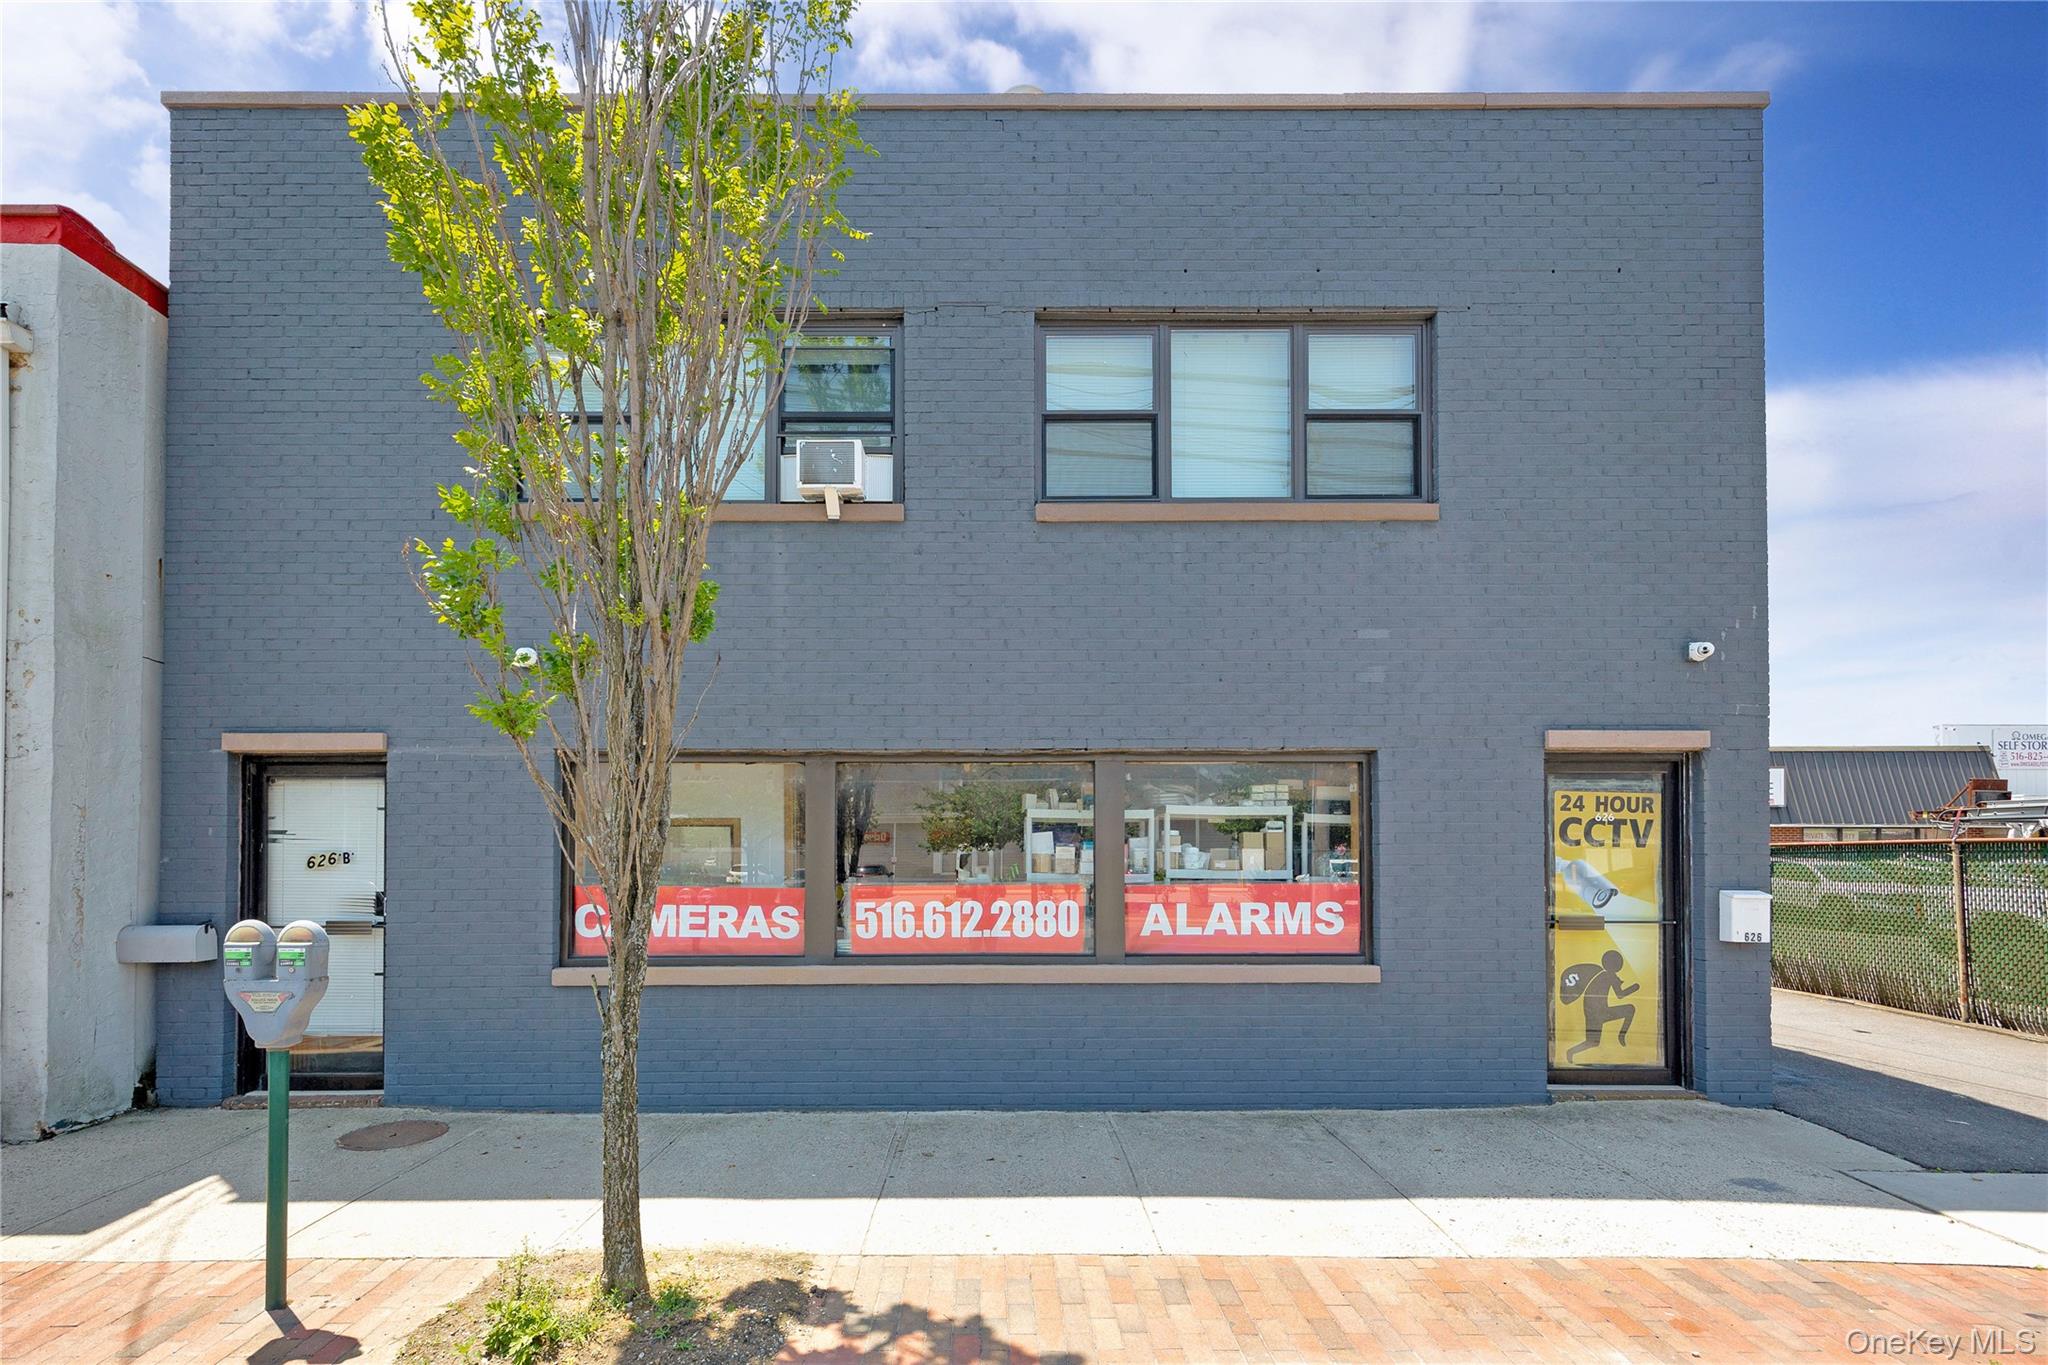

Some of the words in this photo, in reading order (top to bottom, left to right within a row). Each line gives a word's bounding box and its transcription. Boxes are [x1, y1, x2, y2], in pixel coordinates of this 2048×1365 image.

[2022, 733, 2048, 741] OMEG
[1997, 741, 2019, 750] SELF
[2010, 752, 2048, 761] 516-825-
[1560, 794, 1585, 812] 24
[1595, 795, 1655, 814] HOUR
[1594, 812, 1615, 822] 626
[1558, 816, 1655, 848] CCTV
[574, 903, 800, 939] CMERAS
[855, 900, 1080, 938] 516.612.2880
[1140, 901, 1345, 936] ALARMS
[1744, 932, 1762, 942] 626
